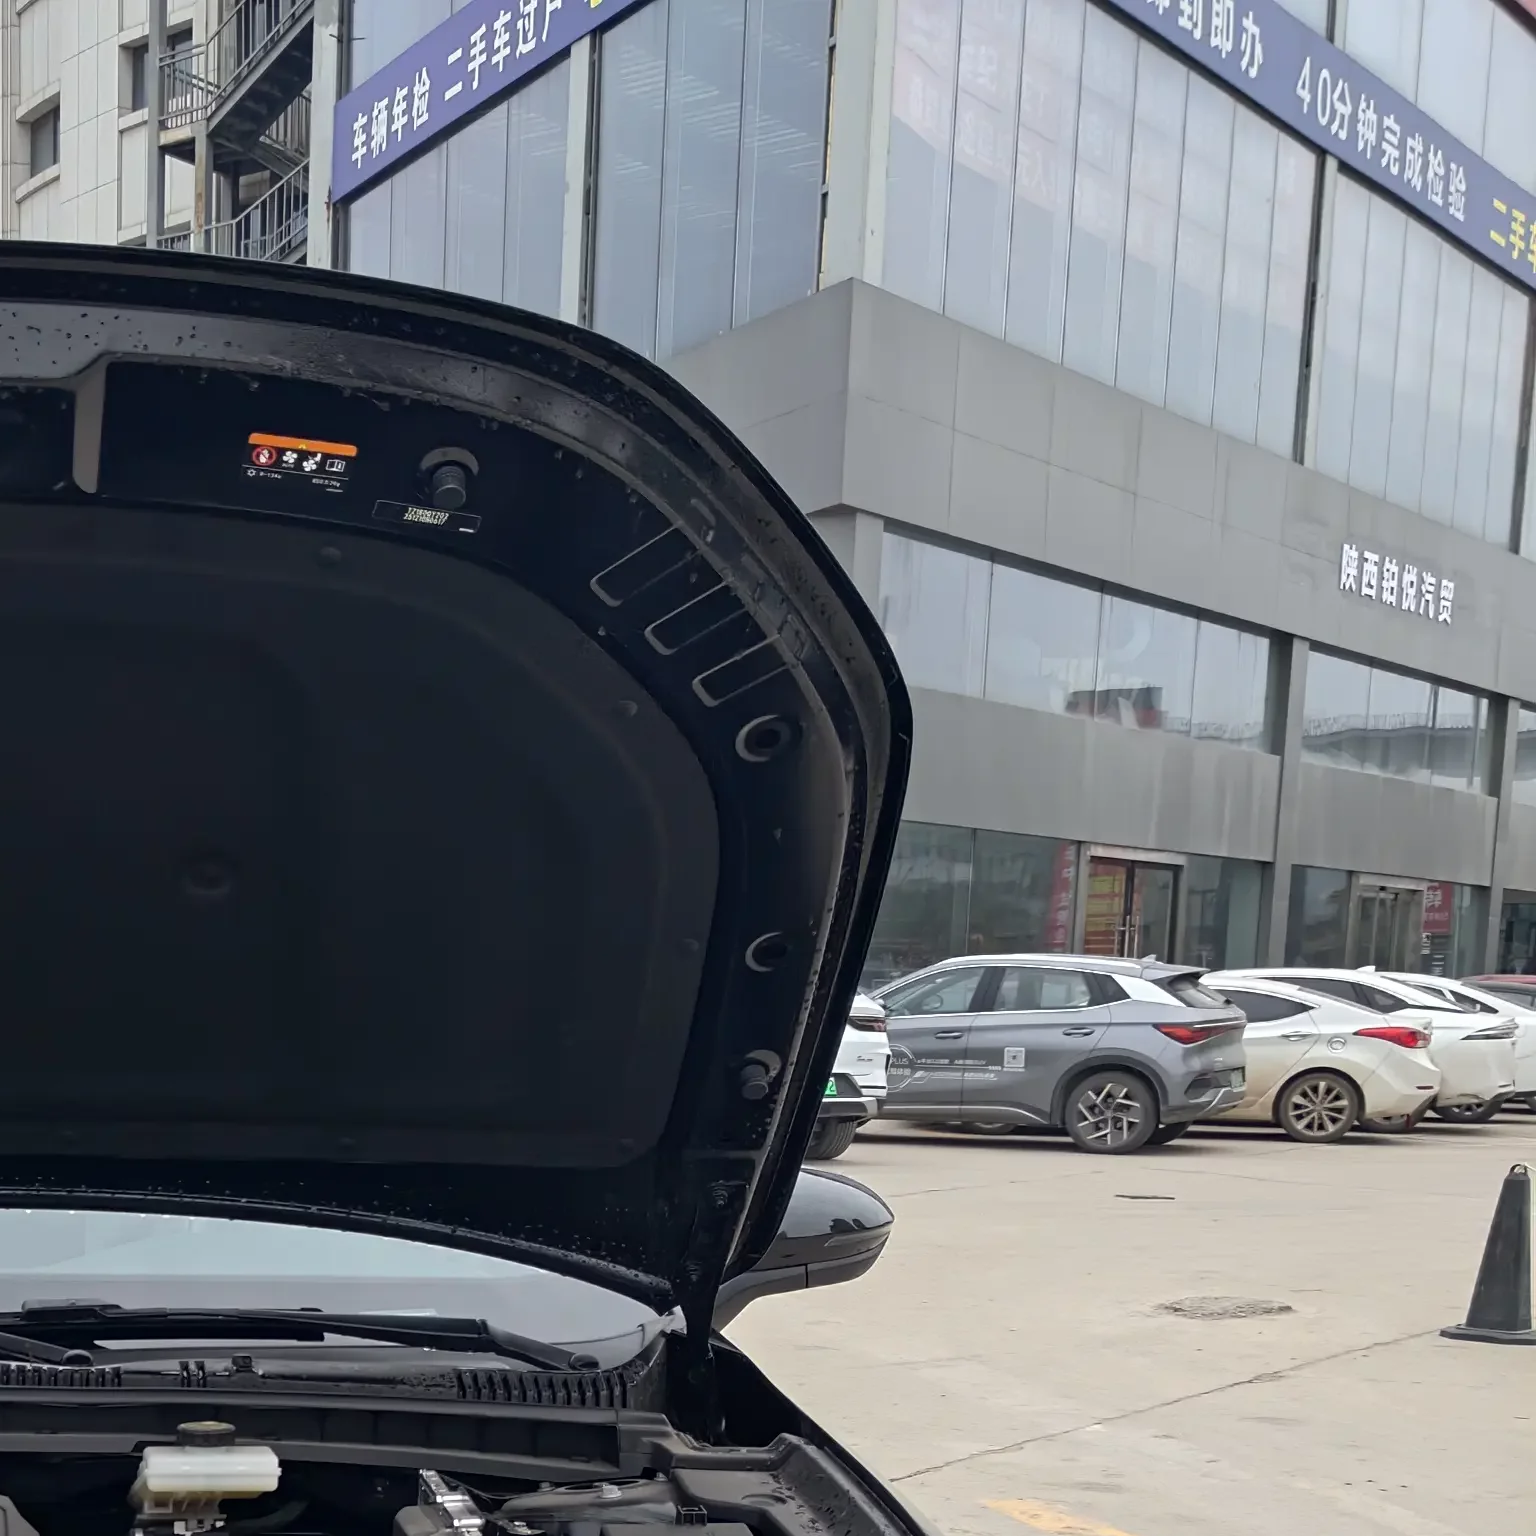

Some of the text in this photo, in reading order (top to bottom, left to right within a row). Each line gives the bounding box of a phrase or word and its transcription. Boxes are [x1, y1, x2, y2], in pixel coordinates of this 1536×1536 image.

[351, 66, 431, 169] 车辆年检
[1147, 0, 1263, 79] 到即办
[1295, 56, 1465, 222] 40分钟完成检验
[1339, 543, 1455, 625] 陕西铂悦汽贸
